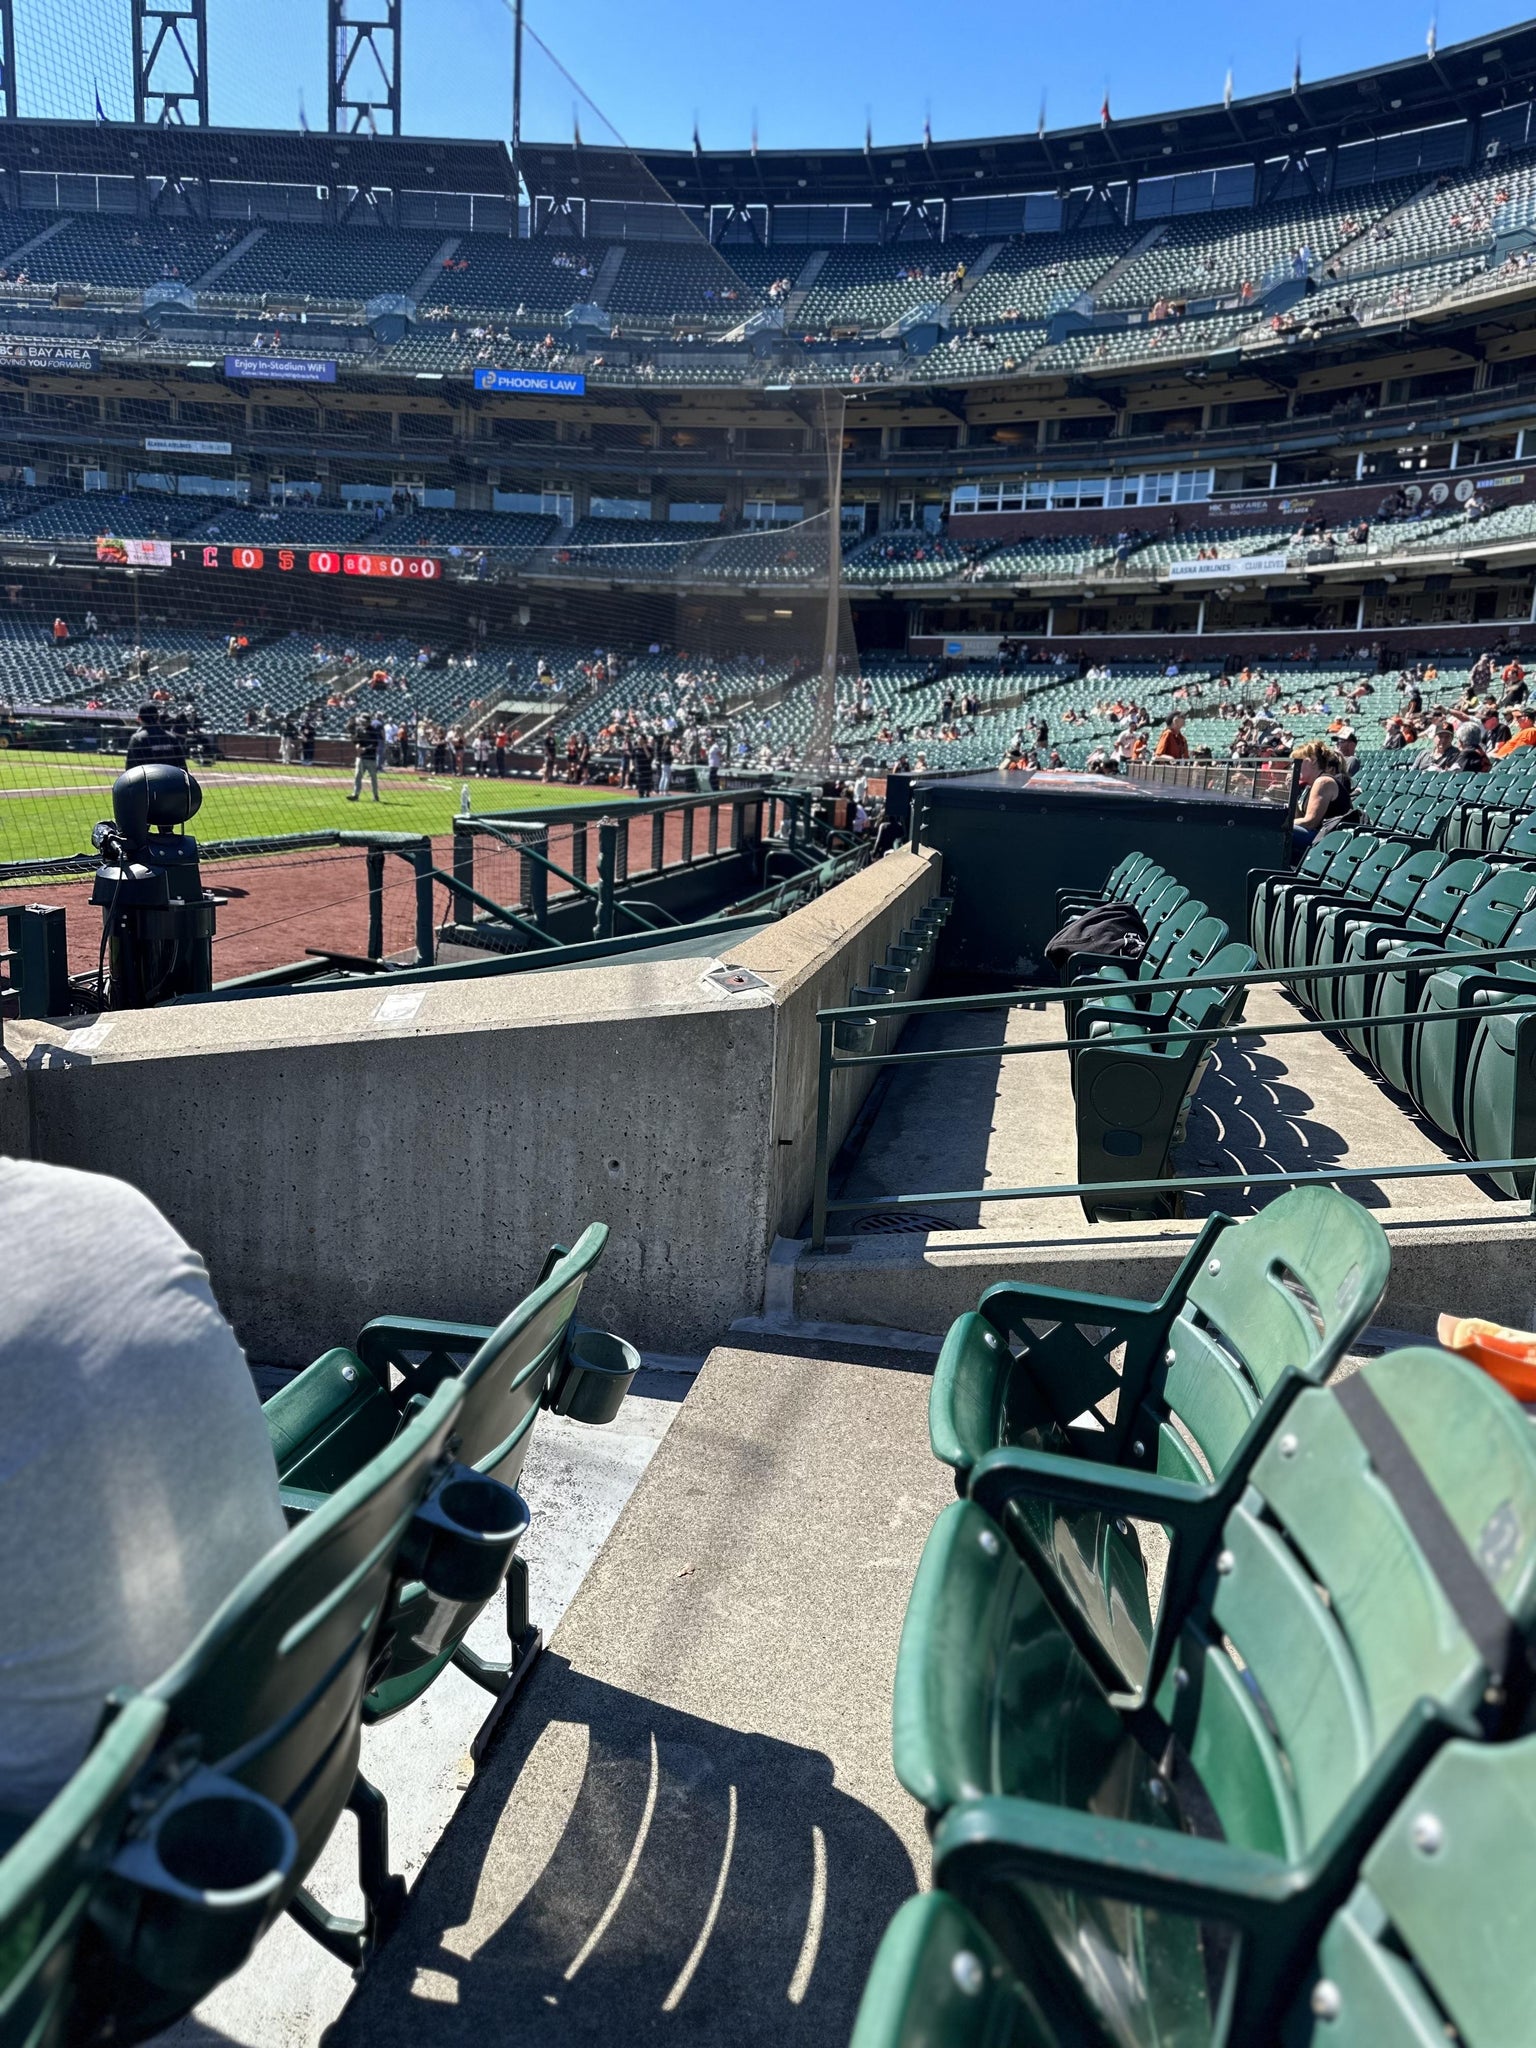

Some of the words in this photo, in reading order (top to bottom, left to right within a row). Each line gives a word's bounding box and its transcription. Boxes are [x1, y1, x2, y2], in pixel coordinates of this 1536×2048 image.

[28, 347, 53, 358] BAY
[55, 348, 91, 360] AREA
[28, 359, 47, 368] YOU
[48, 360, 92, 370] FORWARD
[234, 359, 258, 371] Enjoy
[259, 361, 306, 371] In-Stadium
[307, 363, 326, 373] WiFi
[498, 377, 548, 390] PHOONG
[550, 380, 577, 391] LAW
[180, 550, 186, 560] 1
[241, 549, 255, 568] 0
[318, 553, 331, 573] 0
[358, 556, 371, 574] 0
[390, 558, 404, 576] 0
[421, 560, 435, 578] 0
[1172, 565, 1197, 575] ALASKA
[1198, 564, 1231, 573] AIRLINES
